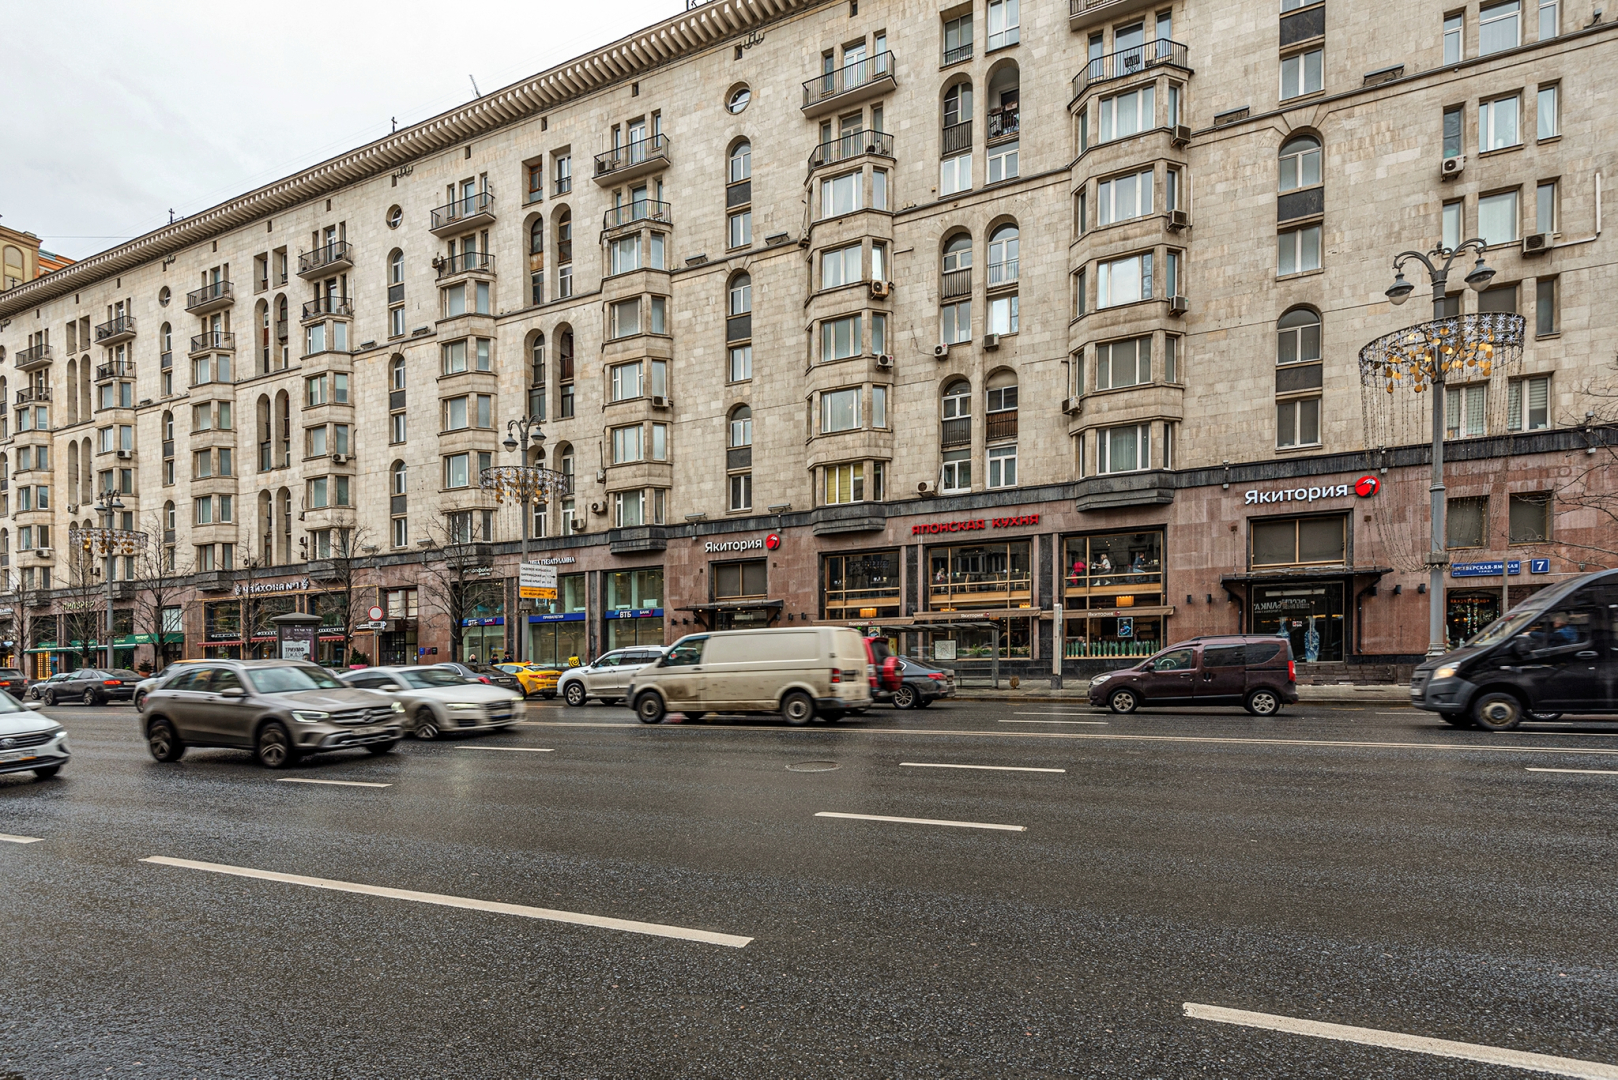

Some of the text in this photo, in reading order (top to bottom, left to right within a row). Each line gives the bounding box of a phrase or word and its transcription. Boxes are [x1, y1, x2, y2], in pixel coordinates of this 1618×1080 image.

[1244, 484, 1348, 505] Якитория
[911, 514, 1039, 535] ЯПОНСКАЯ КУХНЯ
[705, 539, 762, 553] Якитория
[1462, 563, 1519, 571] ТВЕРСКАЯ-ЯМКАЯ
[1536, 561, 1545, 571] 7
[619, 610, 632, 618] ВТБ
